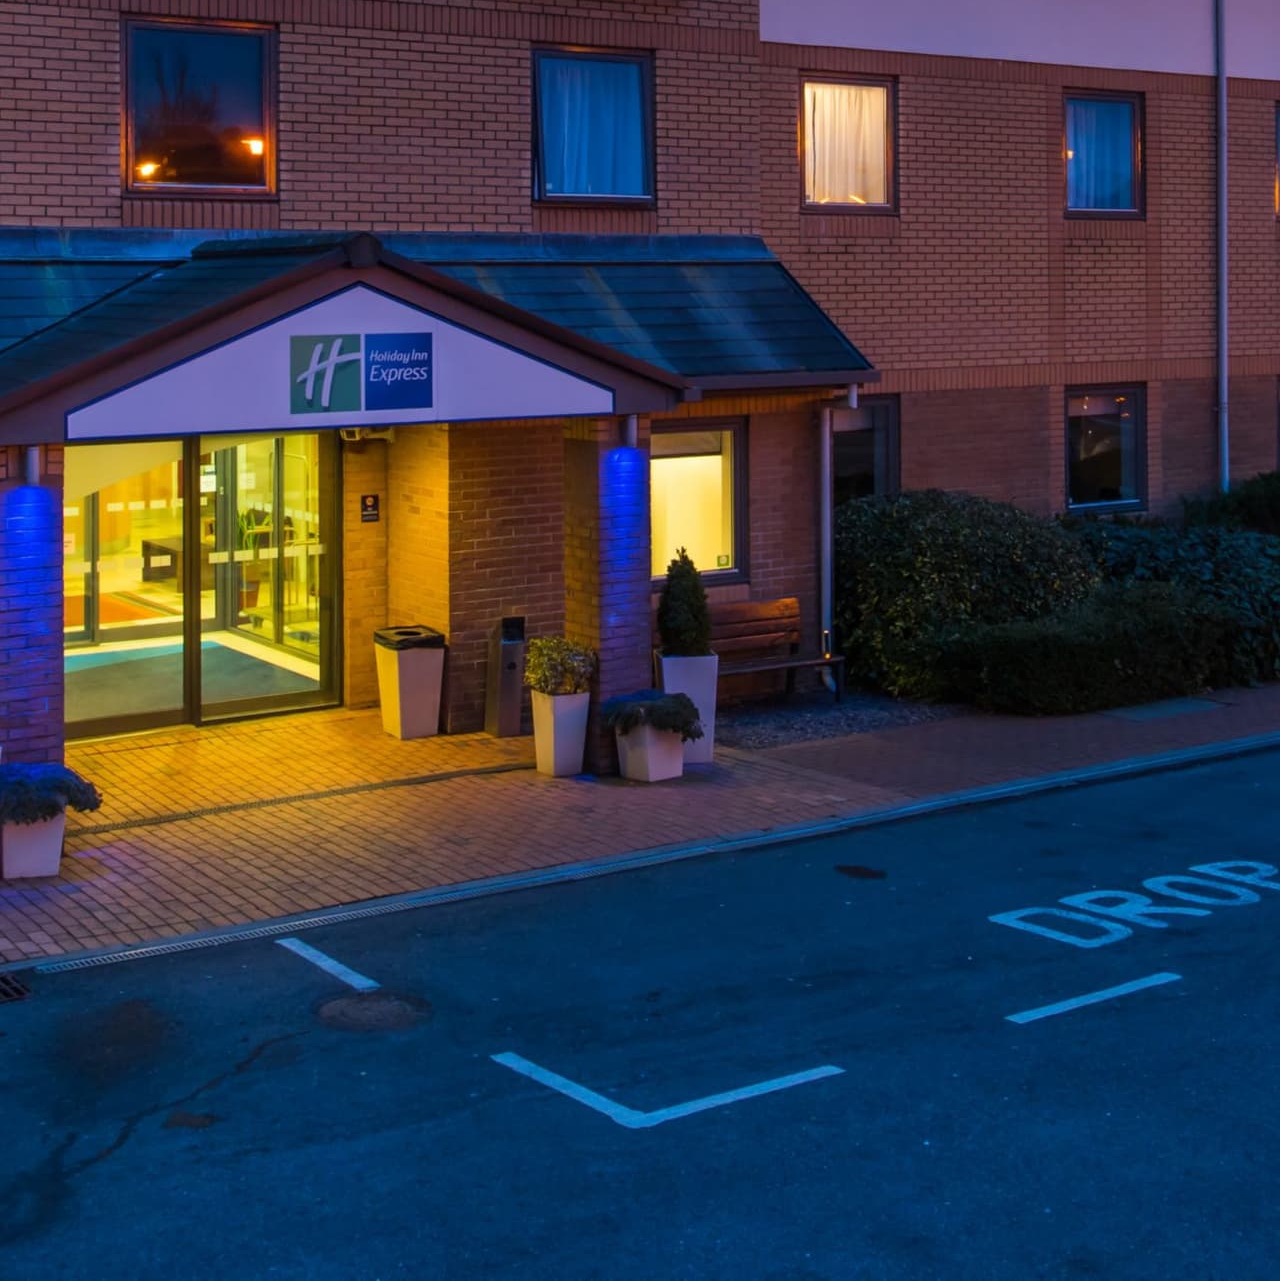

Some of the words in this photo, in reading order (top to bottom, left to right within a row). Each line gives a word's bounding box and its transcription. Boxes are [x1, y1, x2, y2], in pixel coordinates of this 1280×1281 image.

[369, 349, 410, 364] Holiday
[411, 348, 428, 361] Inn
[370, 365, 428, 386] Express
